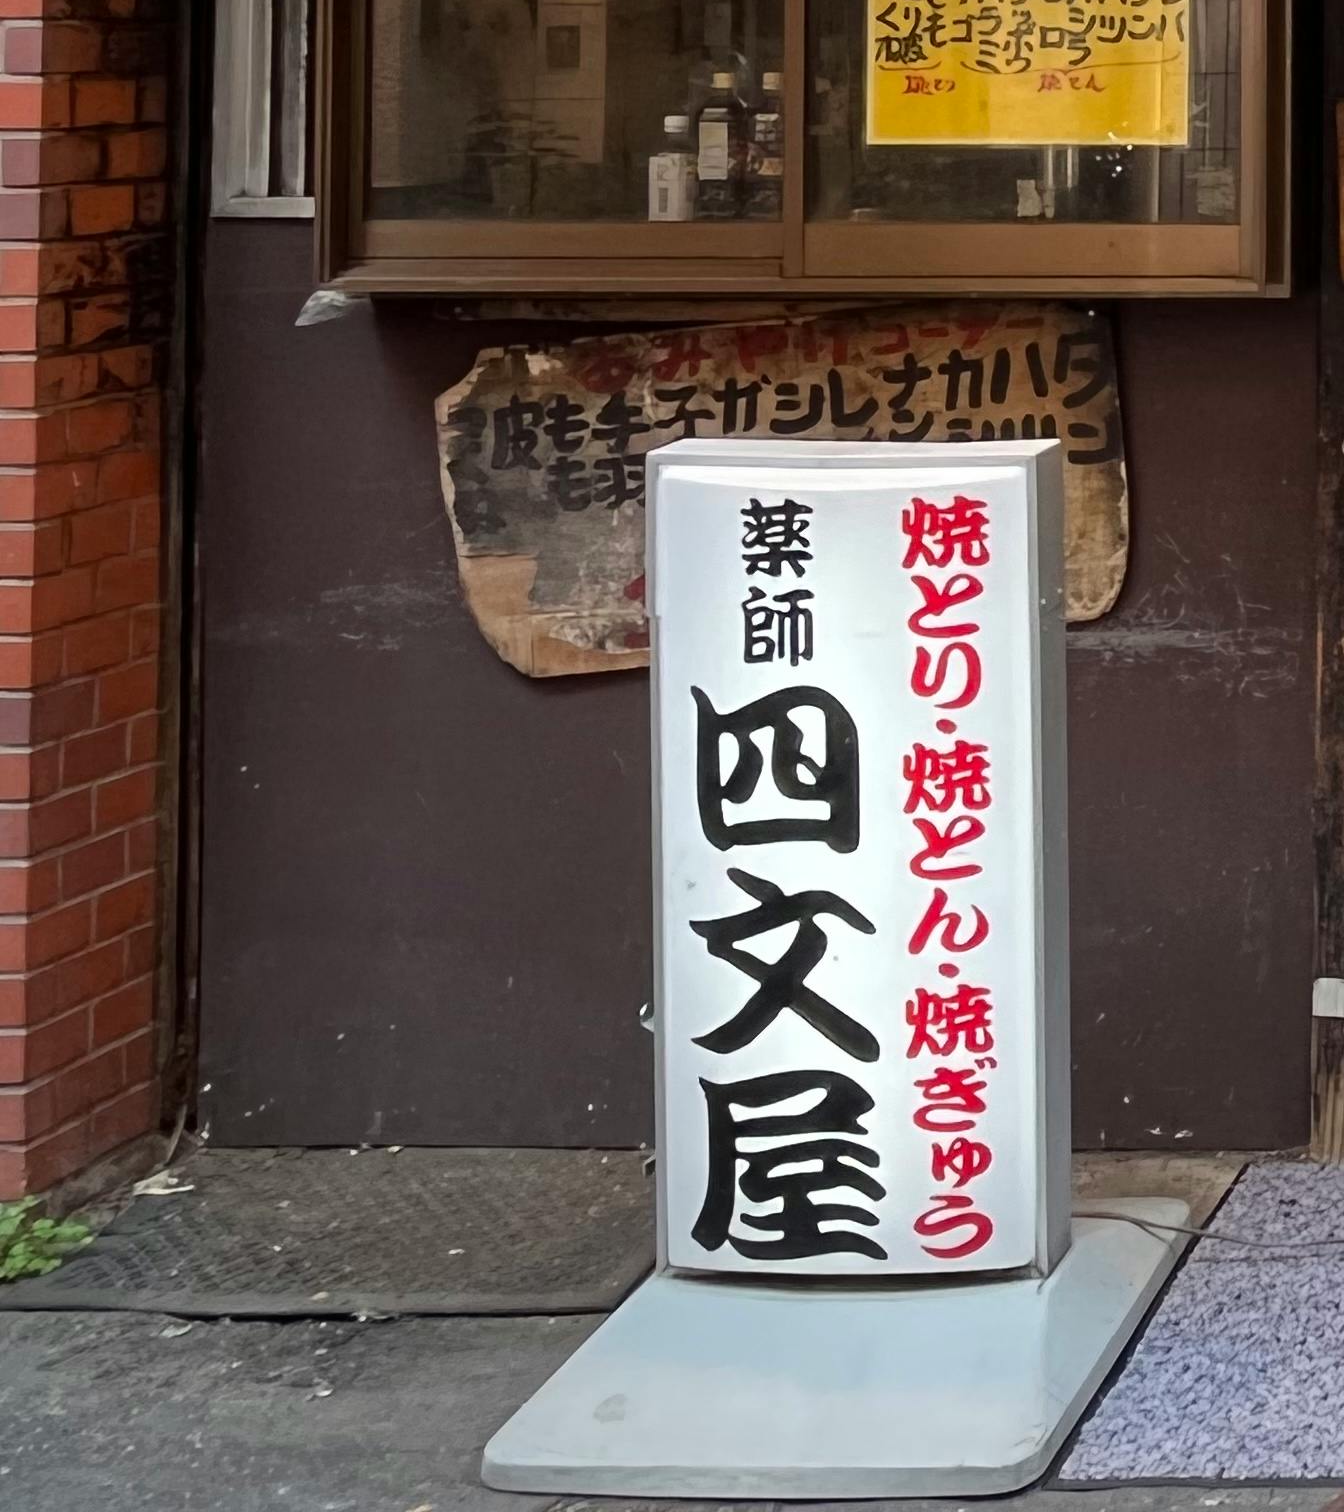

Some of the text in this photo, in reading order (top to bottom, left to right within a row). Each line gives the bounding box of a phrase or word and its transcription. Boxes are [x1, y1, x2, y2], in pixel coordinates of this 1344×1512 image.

[690, 497, 889, 1262] 薬師 四文屋
[900, 495, 1000, 1260] 焼とり・焼とん・焼ぎゅう
